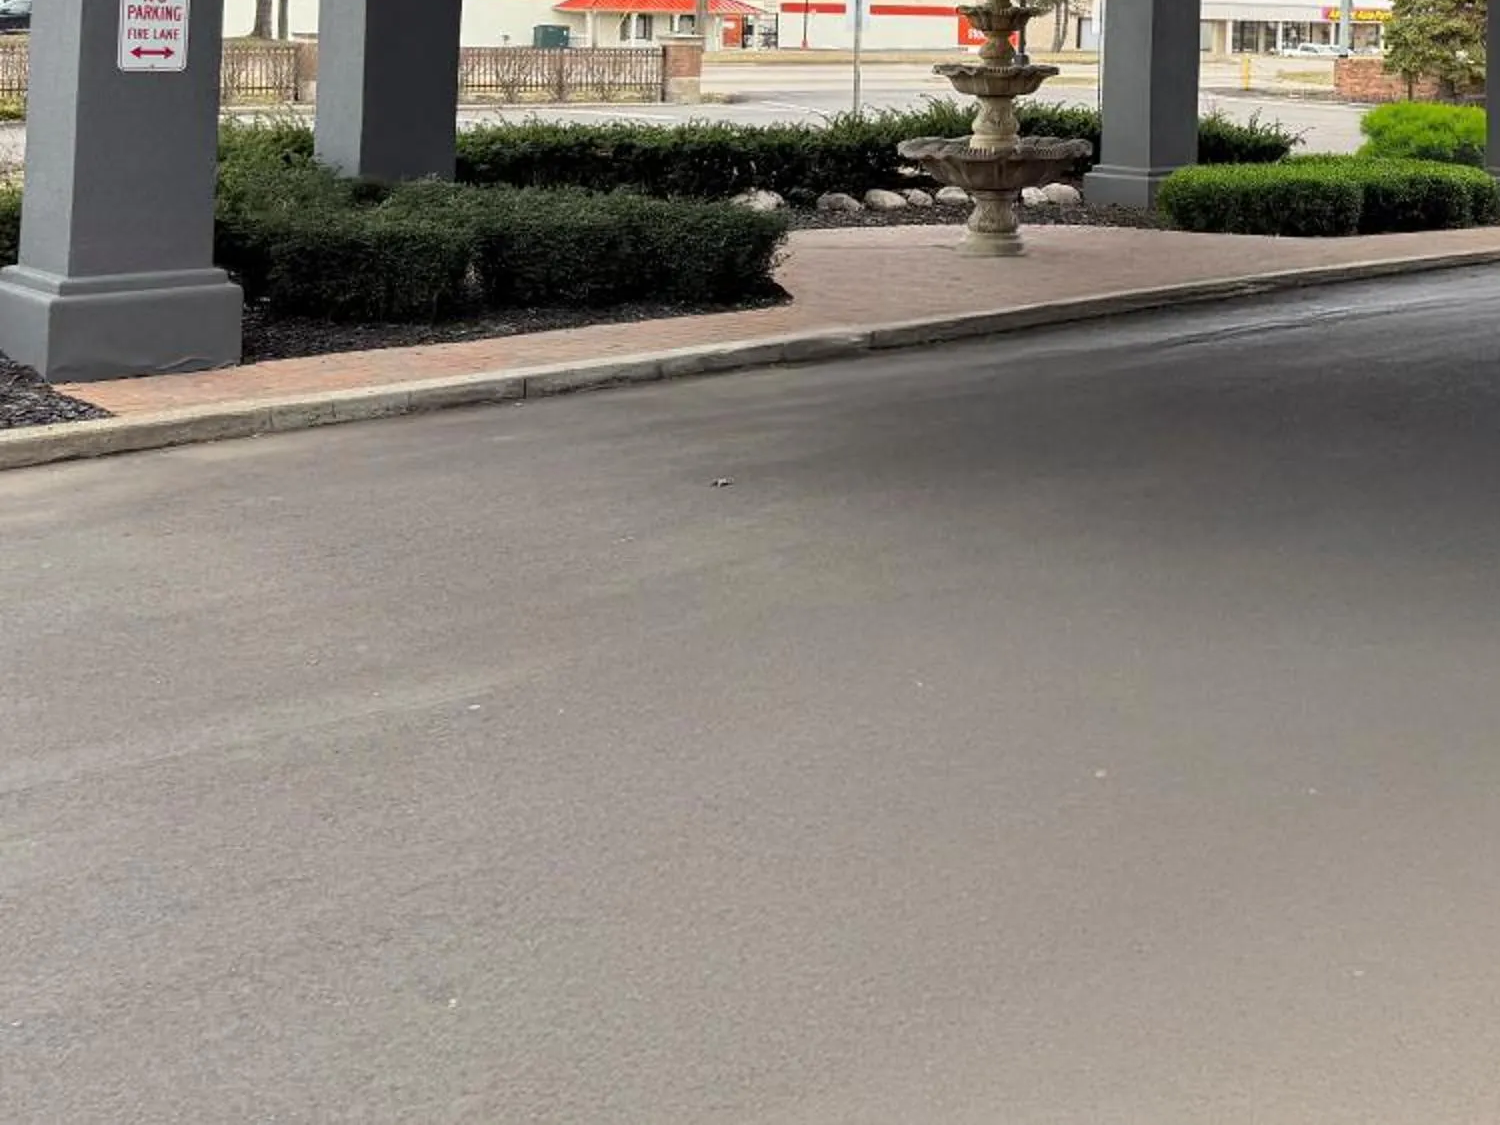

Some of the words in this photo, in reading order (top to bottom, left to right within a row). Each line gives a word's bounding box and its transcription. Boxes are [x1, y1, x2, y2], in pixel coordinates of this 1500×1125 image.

[127, 4, 182, 21] PARKING
[127, 28, 150, 40] FIRE
[152, 28, 180, 40] LANE
